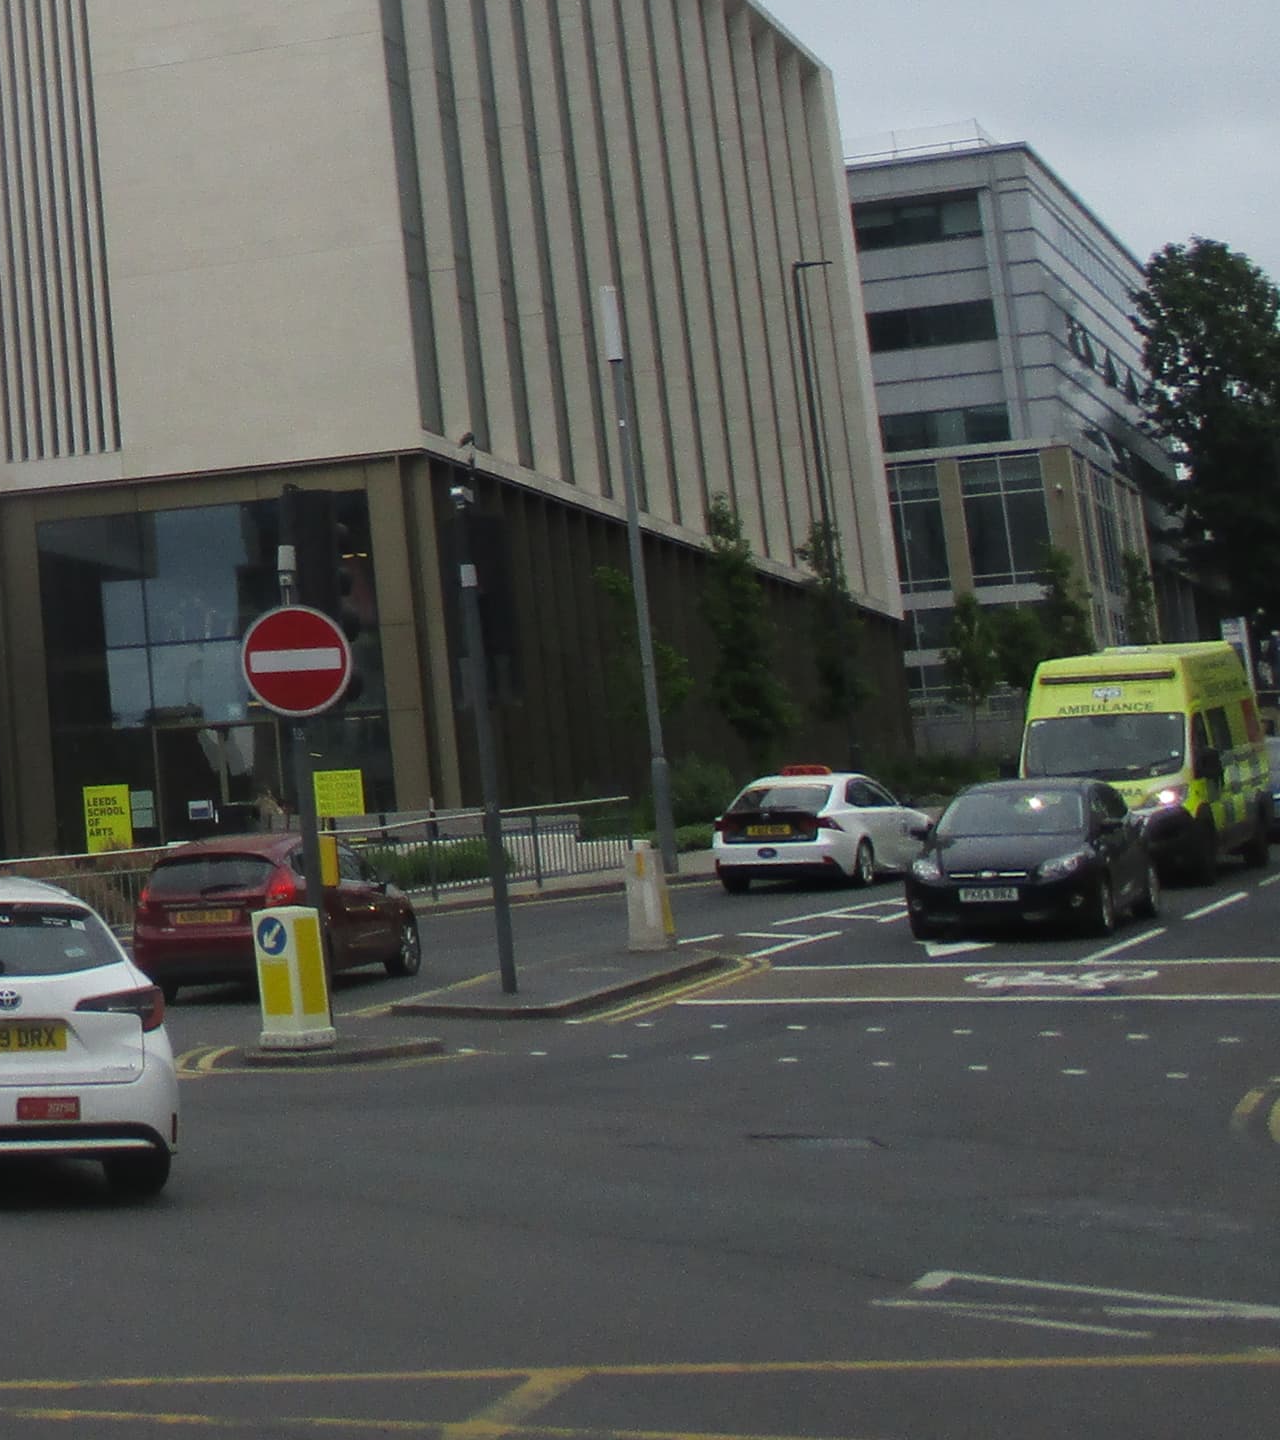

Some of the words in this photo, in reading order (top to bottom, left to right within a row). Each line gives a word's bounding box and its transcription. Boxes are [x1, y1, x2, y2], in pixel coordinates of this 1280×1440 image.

[1057, 702, 1153, 715] AMBULANCE
[86, 797, 117, 807] LEEDS
[87, 807, 125, 817] SCHOOL
[88, 818, 100, 827] OF
[88, 828, 114, 838] ARTS
[17, 1027, 56, 1048] DRX
